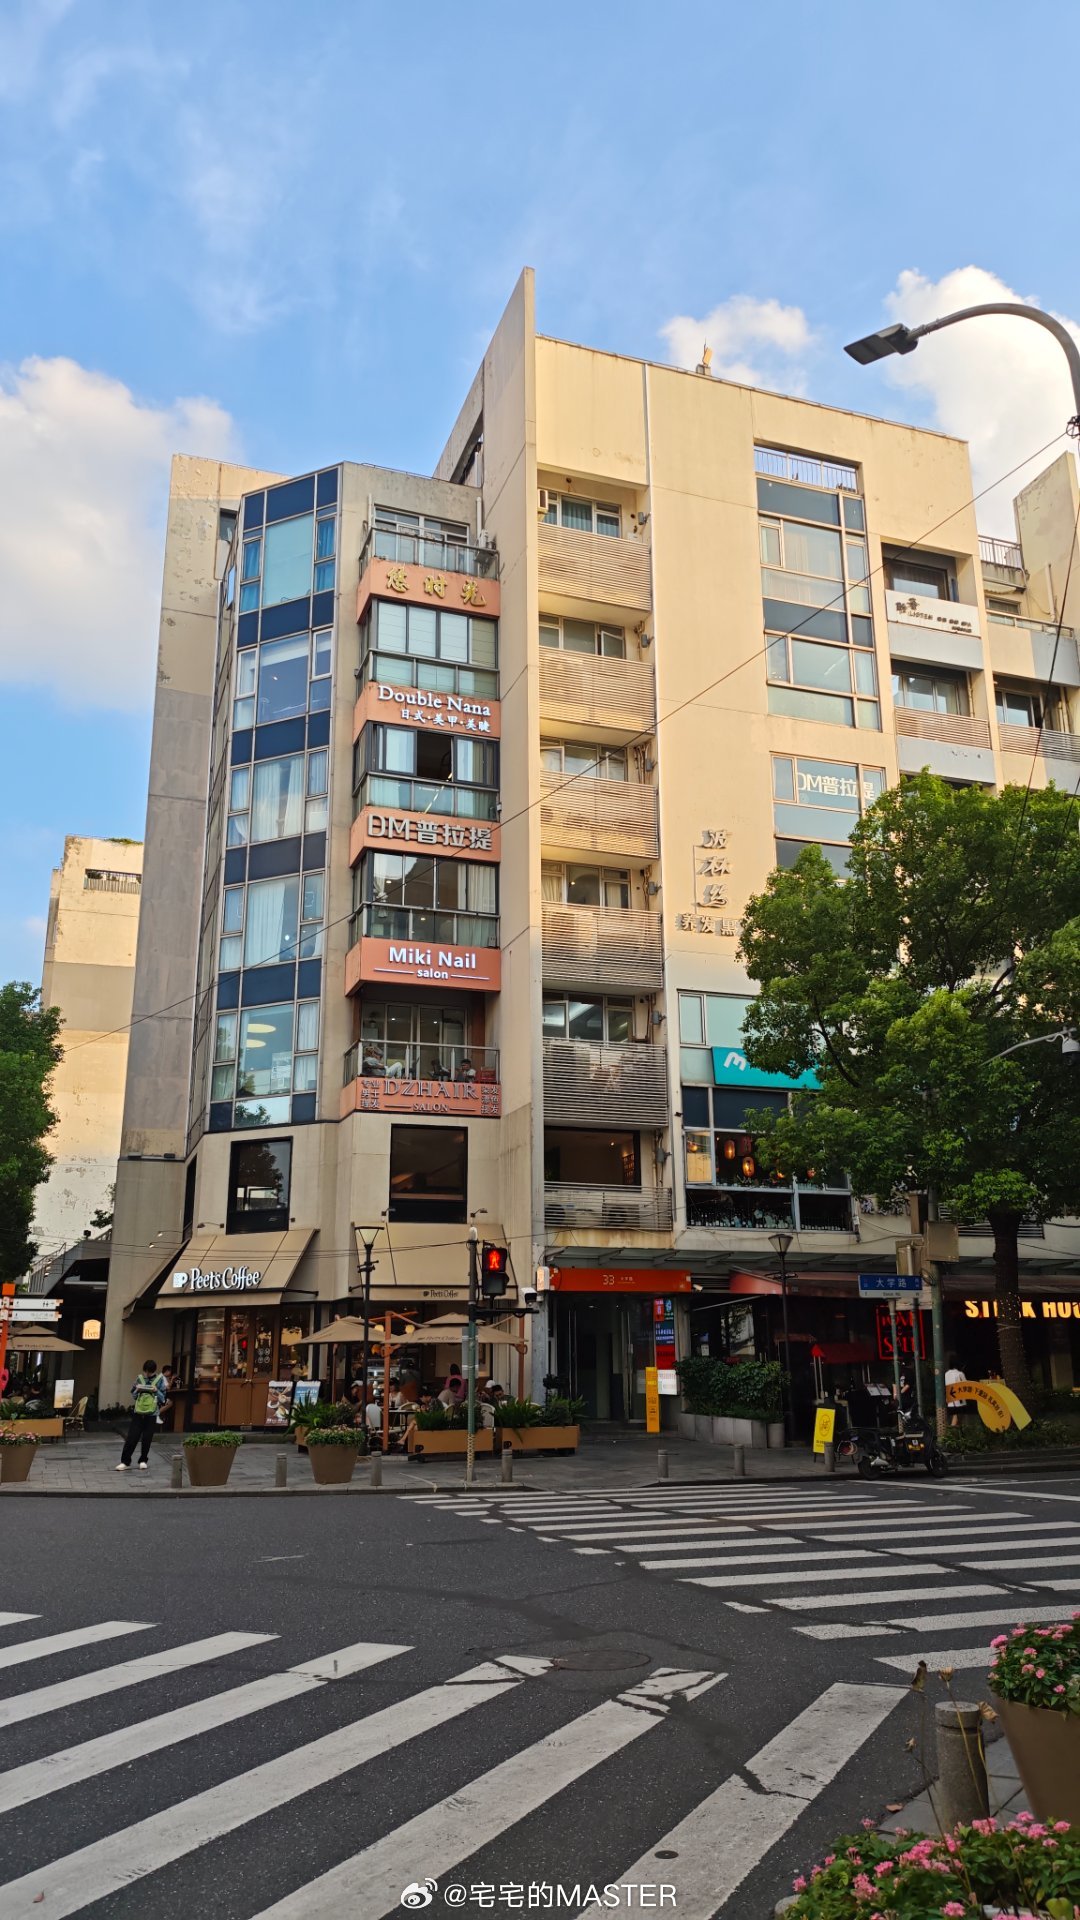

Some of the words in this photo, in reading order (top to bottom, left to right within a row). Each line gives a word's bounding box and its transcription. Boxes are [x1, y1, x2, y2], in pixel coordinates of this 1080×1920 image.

[386, 566, 487, 607] 悠时光
[378, 685, 442, 709] Double
[446, 696, 491, 717] Nana
[367, 813, 493, 850] DM普拉提
[389, 946, 432, 966] Miki
[438, 951, 477, 969] Nail
[417, 968, 449, 980] salon
[384, 1079, 480, 1100] DZHAIR
[412, 1103, 449, 1112] SALON
[222, 1265, 260, 1290] Coffee
[602, 1275, 615, 1286] 33
[875, 1278, 907, 1288] 大学路
